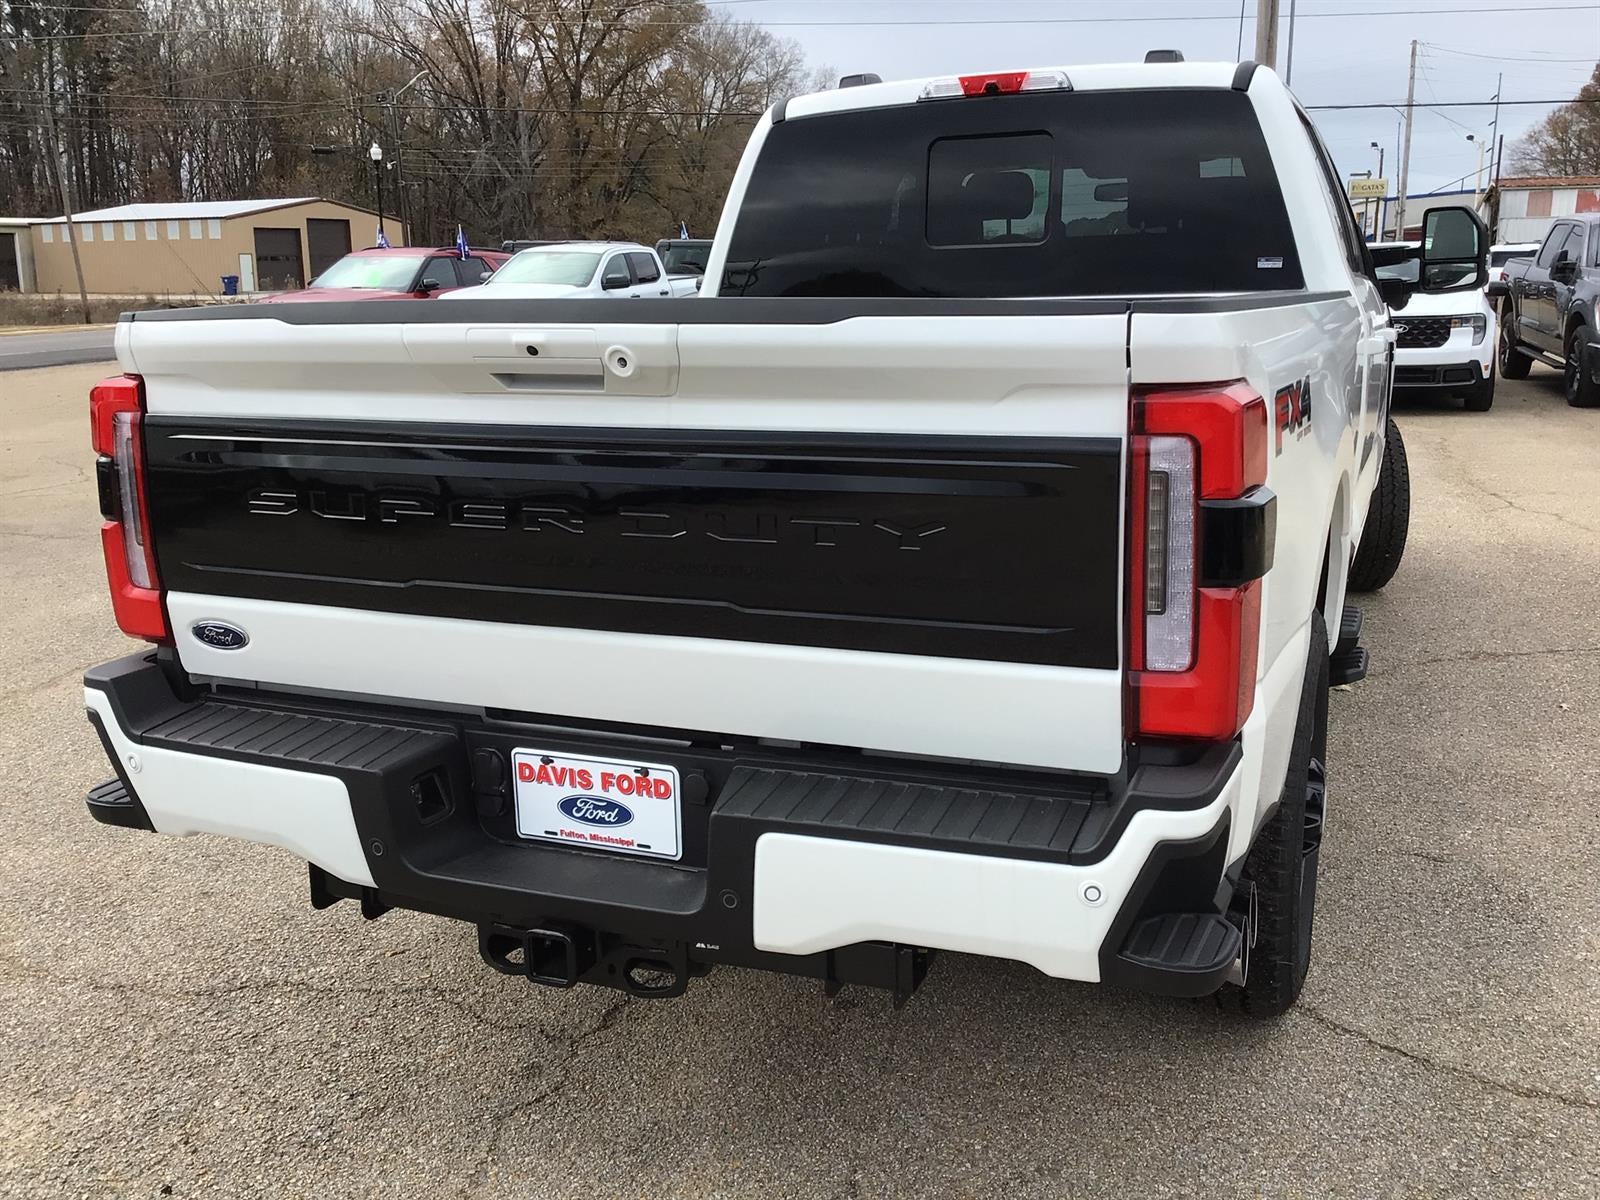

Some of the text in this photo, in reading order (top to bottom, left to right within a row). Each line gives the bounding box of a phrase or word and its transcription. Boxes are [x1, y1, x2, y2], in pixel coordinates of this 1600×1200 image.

[1275, 374, 1311, 458] FX4
[248, 490, 948, 551] SUPER DUTY
[203, 626, 234, 645] Ford
[517, 762, 673, 800] DAVIS FORD
[572, 798, 619, 823] Ford
[559, 829, 635, 847] Fulton, Mississippi
